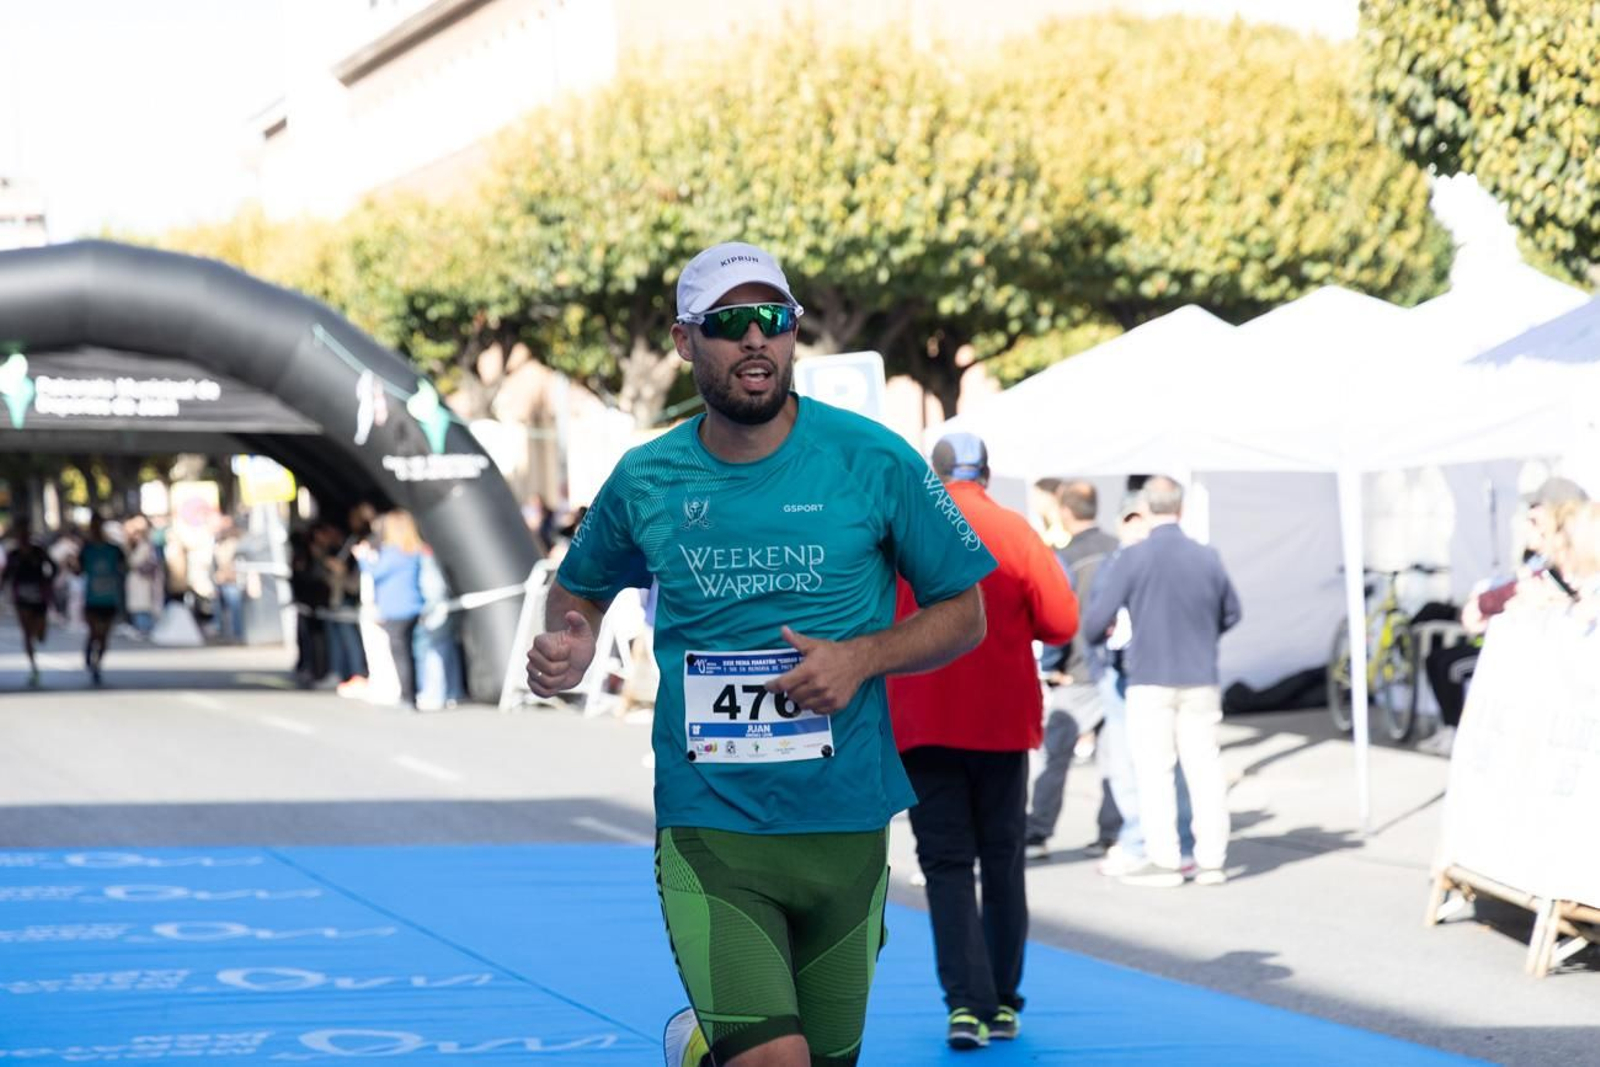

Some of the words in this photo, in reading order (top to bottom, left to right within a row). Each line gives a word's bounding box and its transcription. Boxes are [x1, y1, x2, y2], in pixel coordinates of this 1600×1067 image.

[720, 255, 759, 267] KIPRUN
[783, 503, 824, 513] GSPORT
[679, 544, 824, 572] WEEKEND
[700, 571, 823, 599] WARRIORS
[713, 684, 802, 720] 476
[746, 724, 771, 734] JUAN
